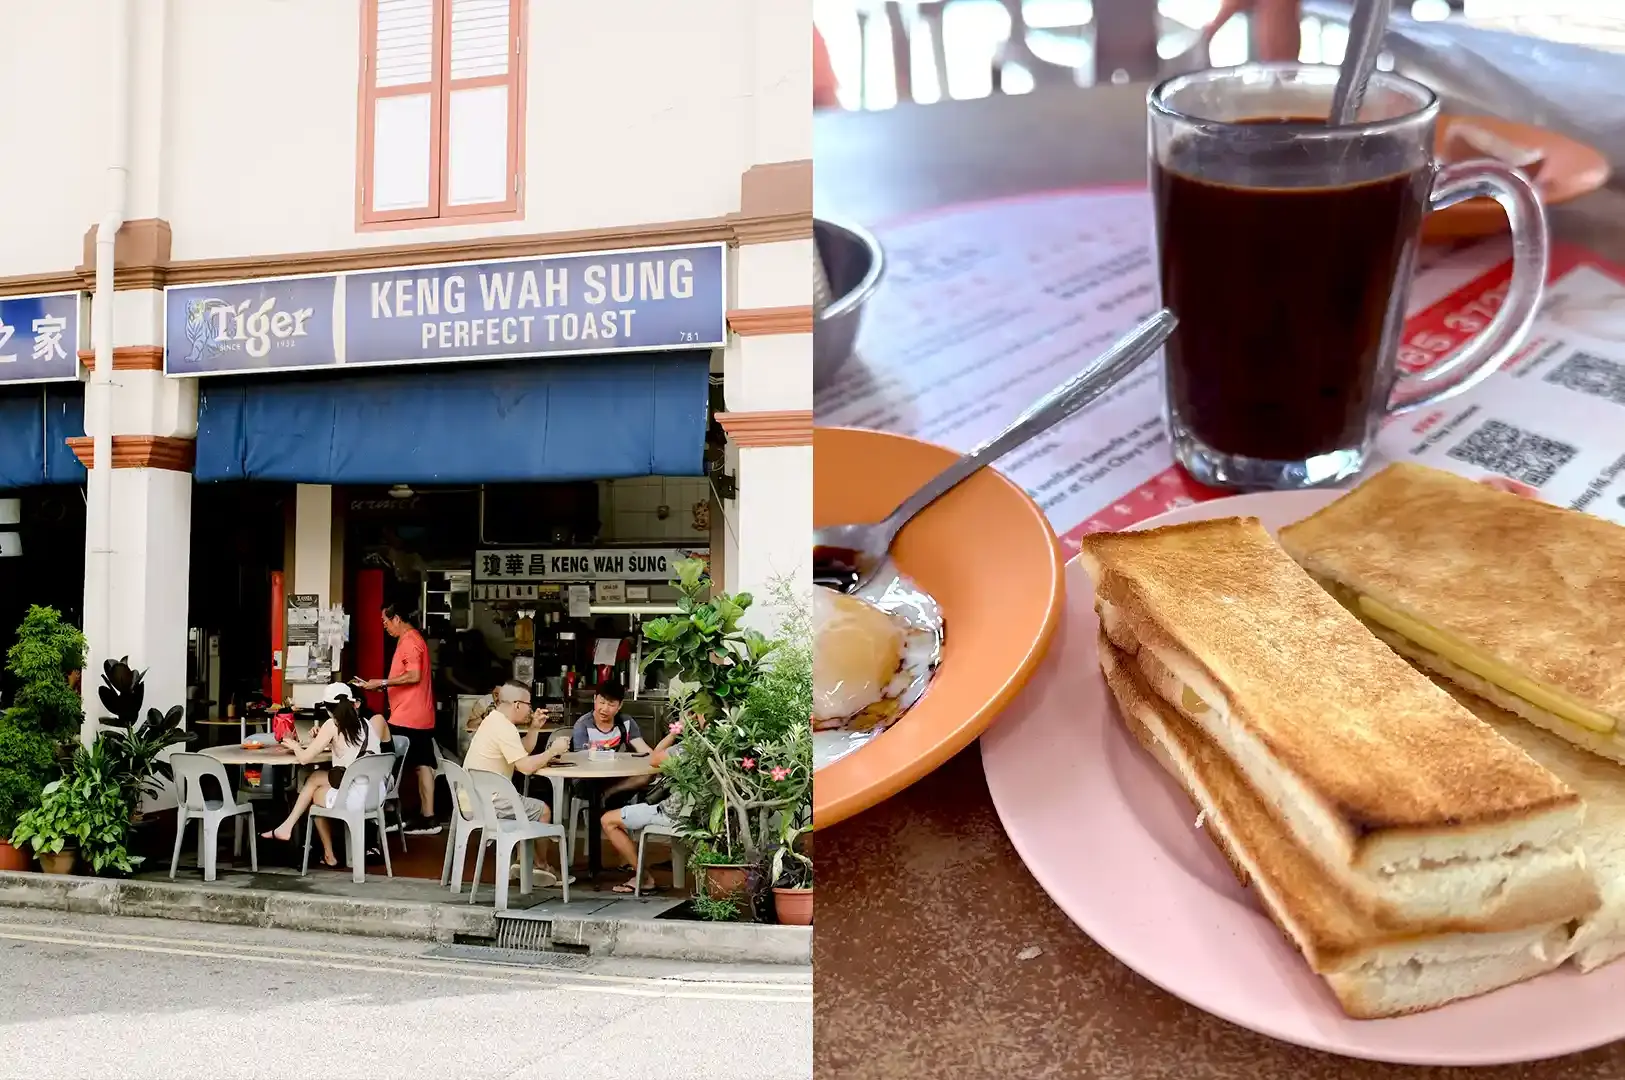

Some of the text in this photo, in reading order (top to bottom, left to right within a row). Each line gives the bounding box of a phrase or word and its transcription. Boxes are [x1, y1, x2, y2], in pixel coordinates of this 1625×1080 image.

[371, 259, 694, 319] KENG WAH SUNG
[209, 297, 314, 357] Tiger
[422, 309, 637, 349] PERFECT TOAST
[680, 331, 699, 342] 781
[551, 556, 588, 573] KENG
[594, 556, 624, 573] WAH
[628, 556, 667, 573] SUNG
